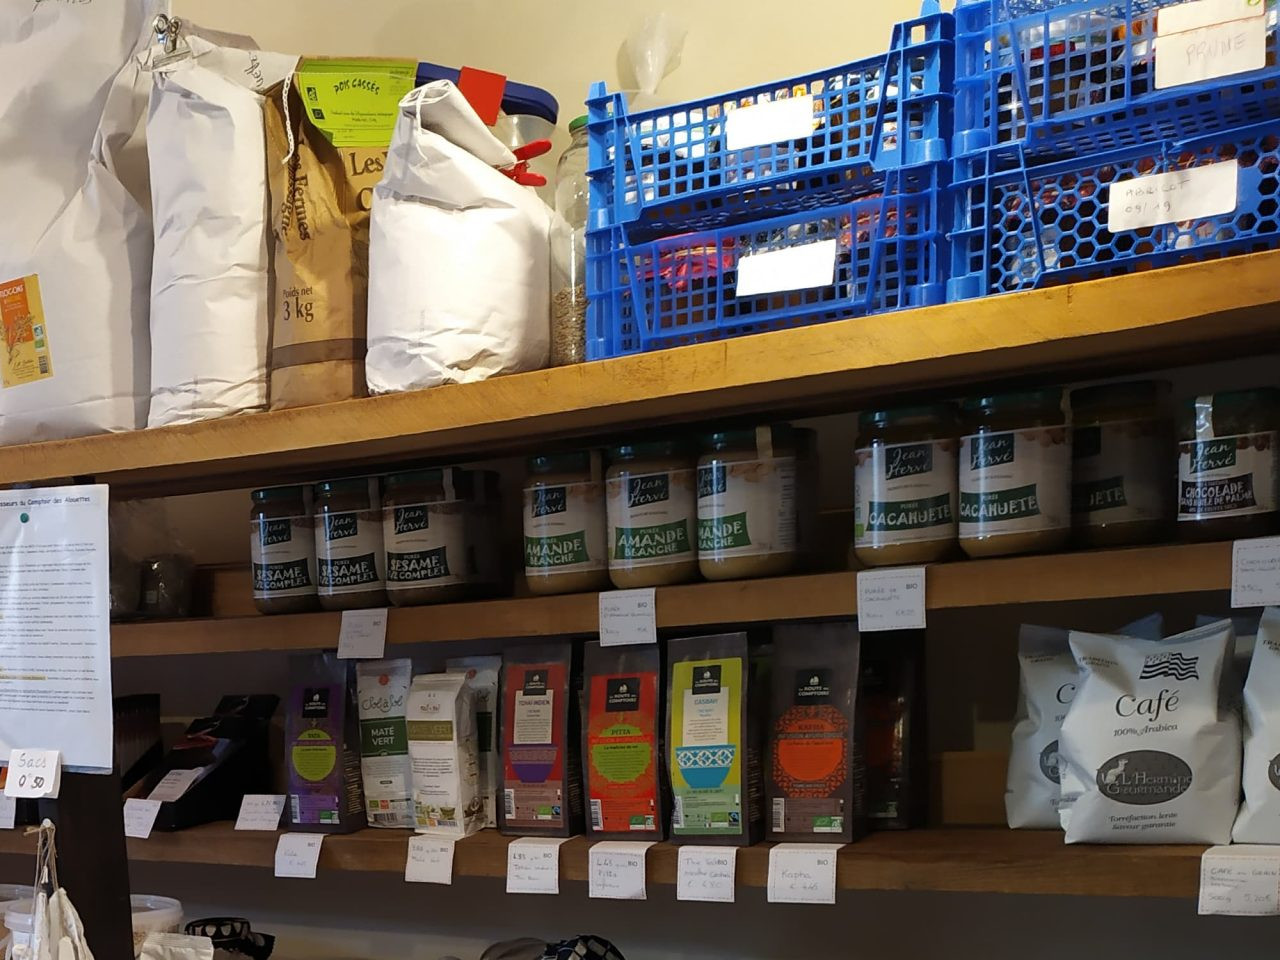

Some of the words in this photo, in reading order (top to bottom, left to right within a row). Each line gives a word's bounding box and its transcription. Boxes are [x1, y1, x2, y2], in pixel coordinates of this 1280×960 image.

[333, 79, 350, 95] POIS
[293, 174, 312, 241] Fermes
[283, 287, 299, 298] Poids
[301, 286, 313, 296] net
[283, 300, 291, 321] 3
[295, 297, 314, 323] kg
[28, 498, 51, 507] Comptoir
[53, 497, 63, 505] des
[64, 495, 91, 504] Alouettes
[960, 495, 1038, 518] CACAHUETE
[869, 502, 952, 526] CACAHUETE
[619, 527, 686, 548] AMANDE
[390, 555, 441, 572] SESAME
[1115, 688, 1181, 723] Café
[371, 726, 396, 738] MATÉ
[1113, 727, 1139, 738] 100%
[1137, 722, 1179, 737] Arabica
[371, 736, 395, 747] VERT
[17, 752, 47, 769] Sacs
